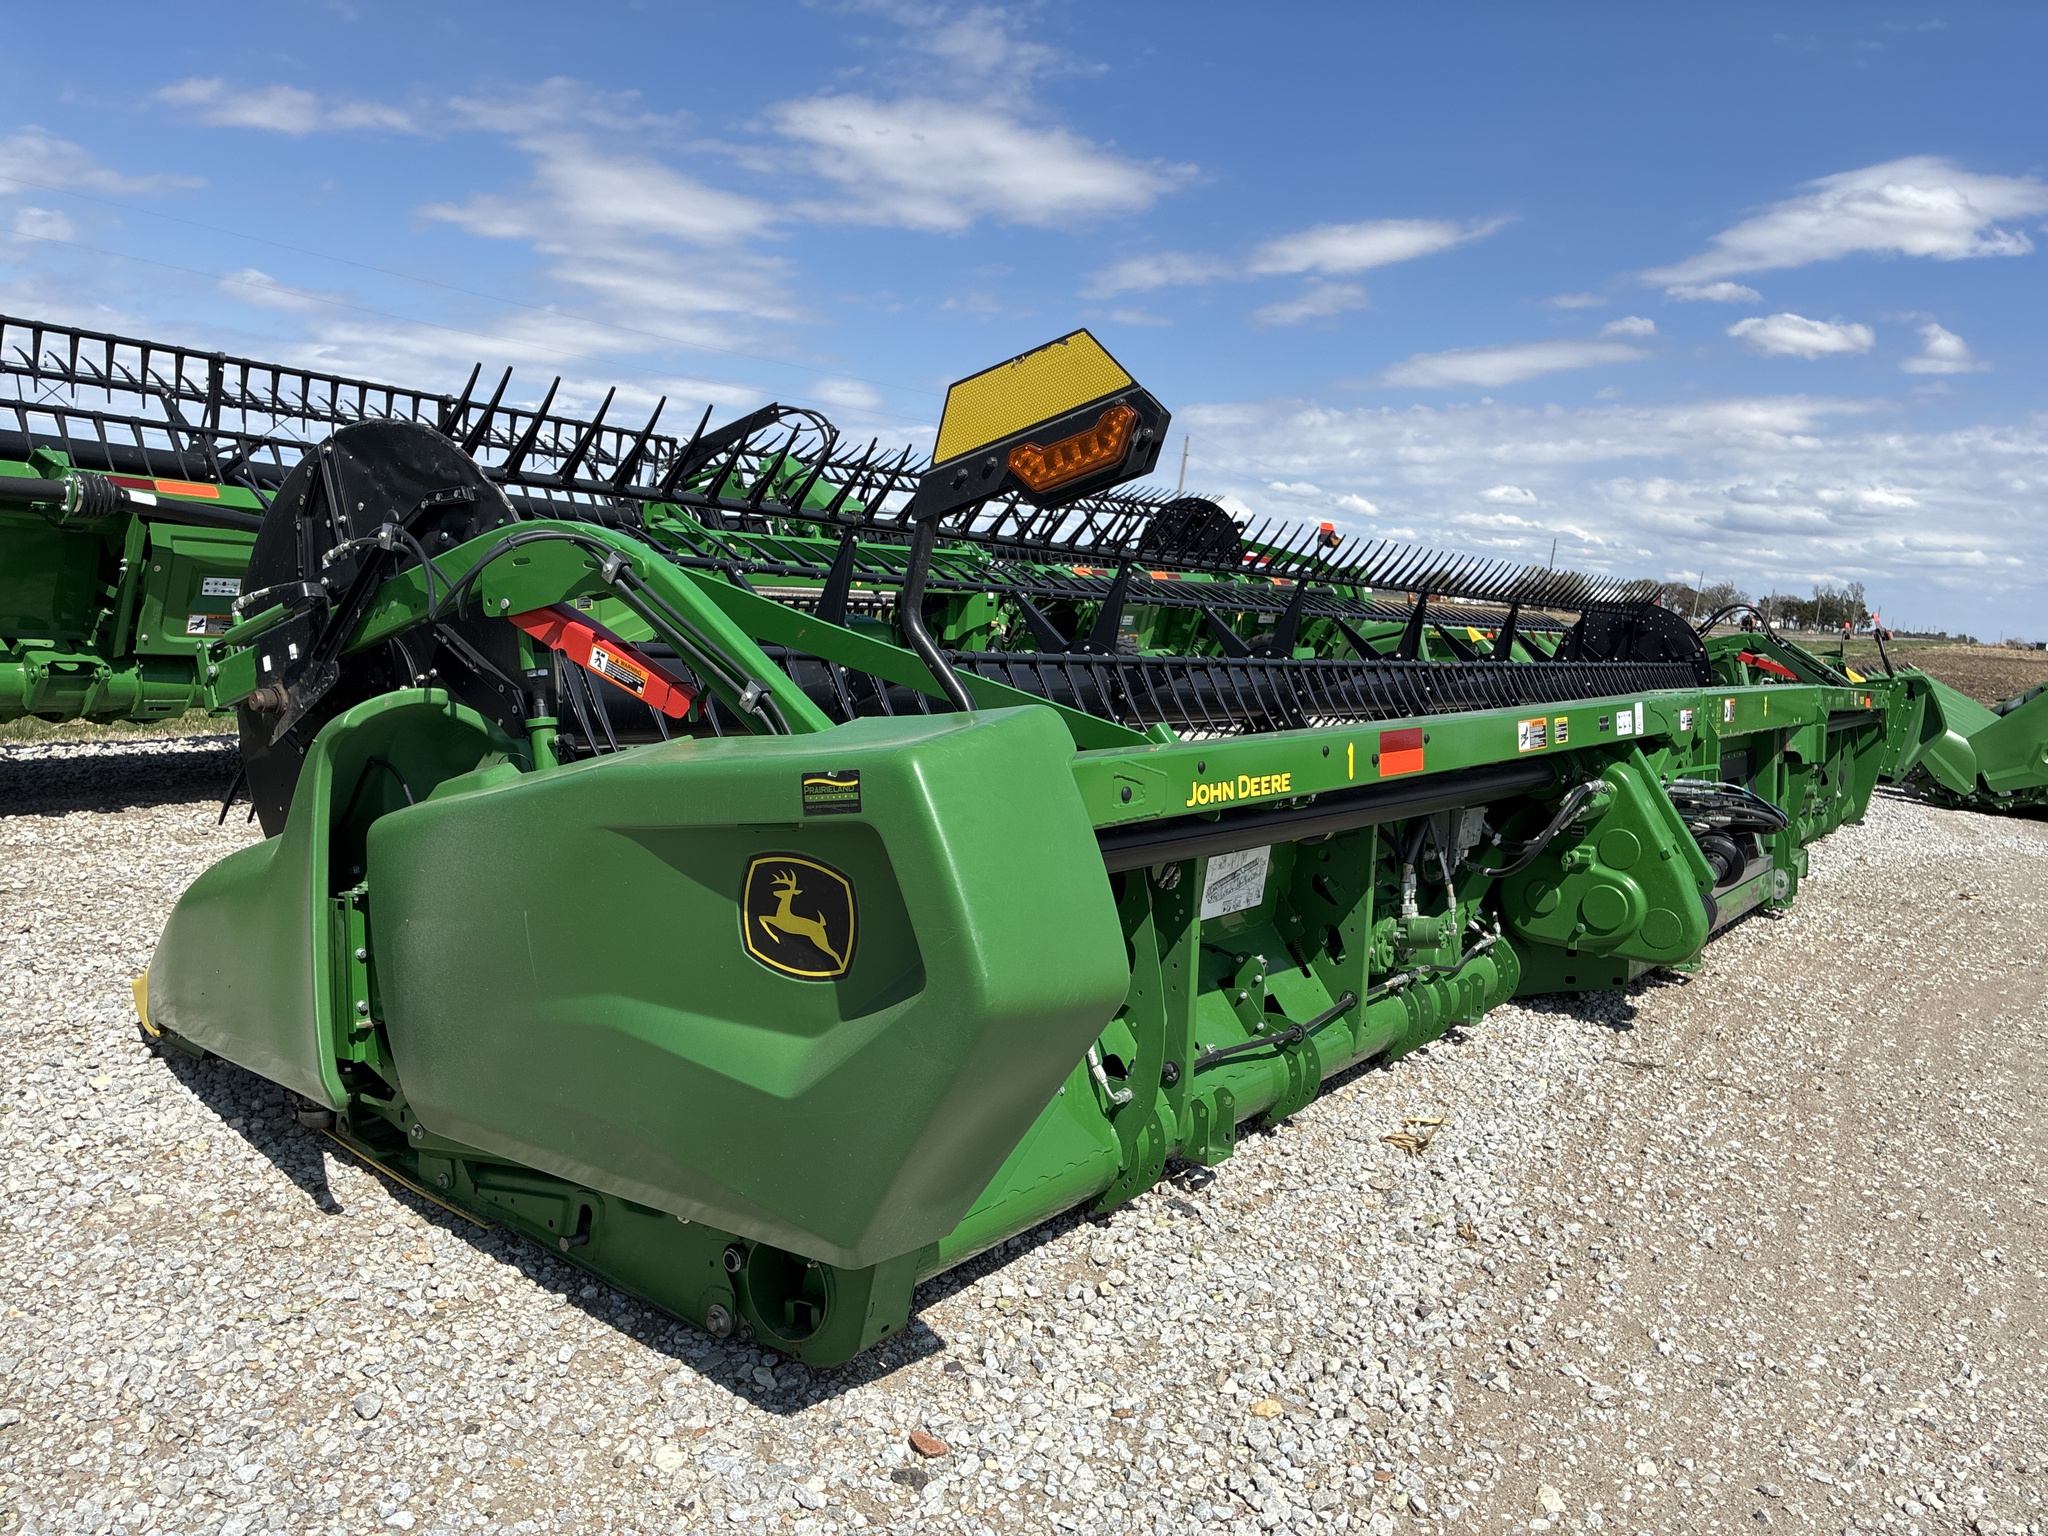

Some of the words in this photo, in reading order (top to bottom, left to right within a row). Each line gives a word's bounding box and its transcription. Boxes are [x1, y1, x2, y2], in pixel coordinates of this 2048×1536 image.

[804, 785, 855, 794] PRAIRIELAND
[1186, 780, 1235, 808] JOHN
[1237, 772, 1292, 799] DEERE
